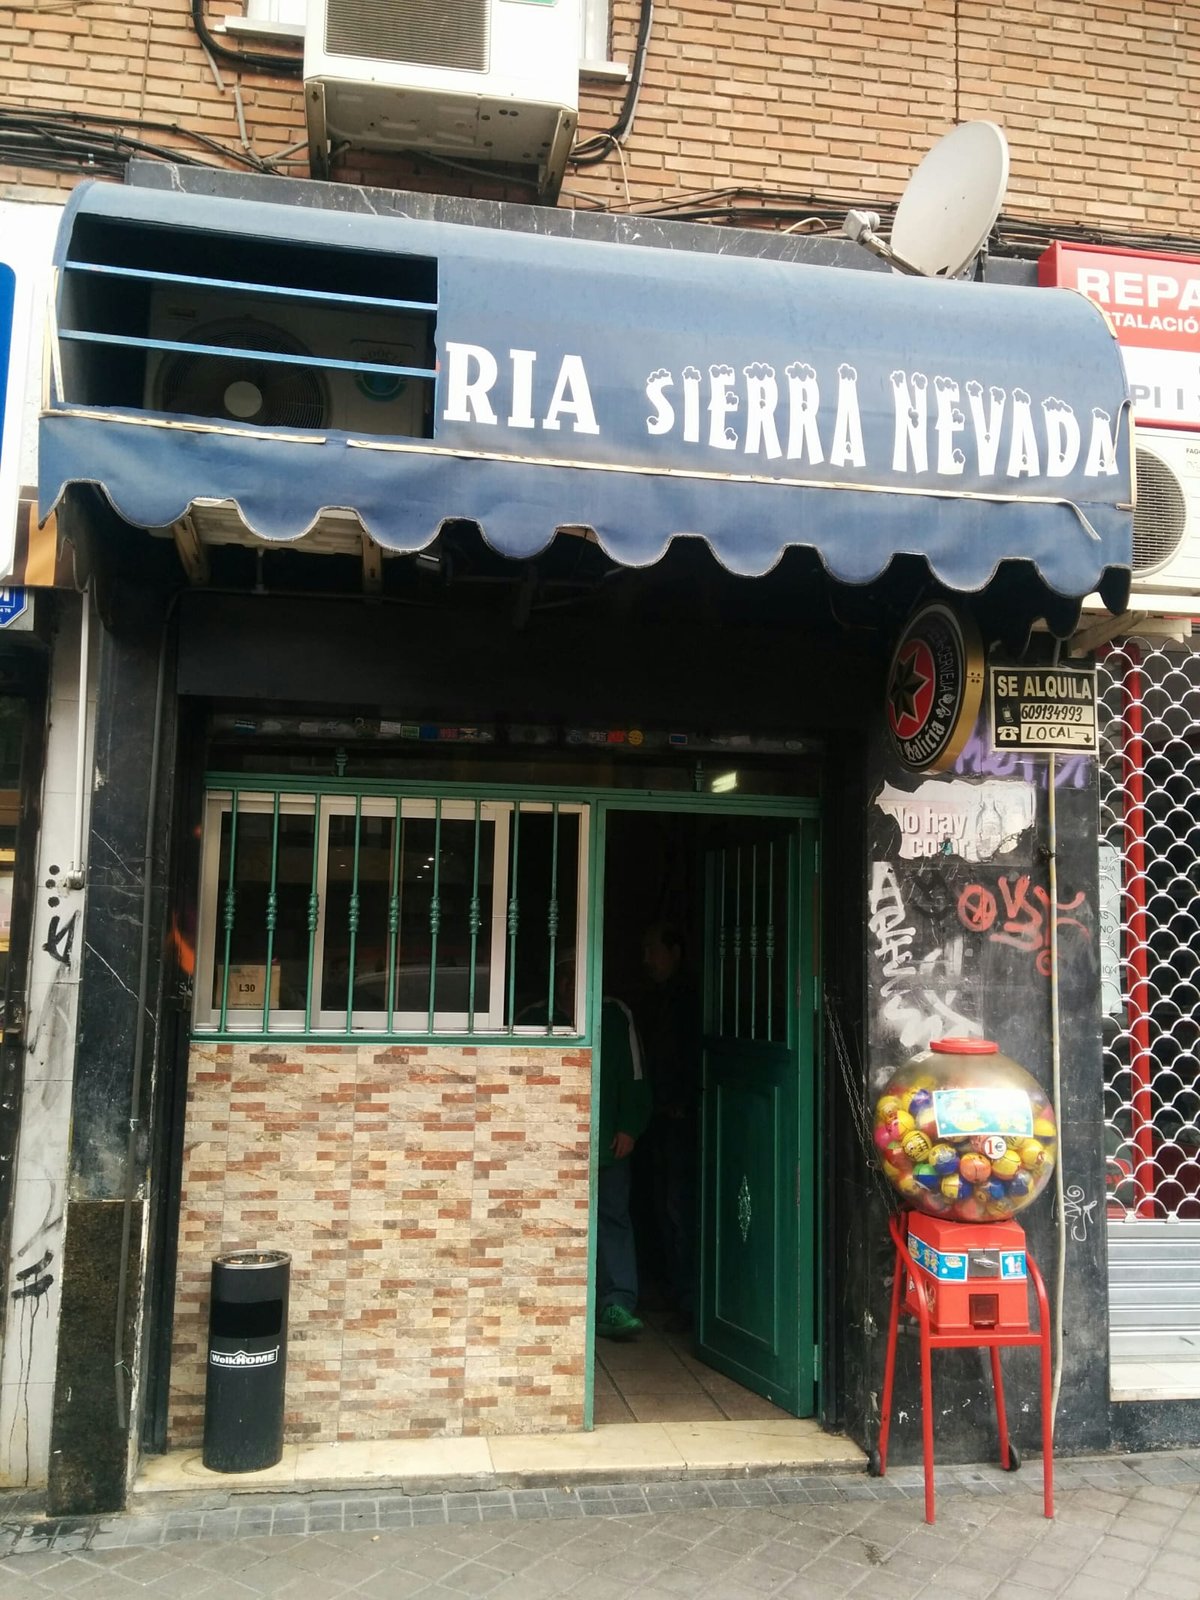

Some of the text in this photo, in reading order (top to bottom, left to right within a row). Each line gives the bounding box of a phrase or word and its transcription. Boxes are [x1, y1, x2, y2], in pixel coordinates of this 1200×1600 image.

[443, 341, 1119, 479] RIA SIERRA NEVADA
[997, 675, 1093, 700] SE ALQUILA
[1021, 704, 1083, 722] 609134993
[1026, 726, 1075, 740] LOCAL
[926, 806, 967, 840] hay
[239, 983, 256, 993] L30
